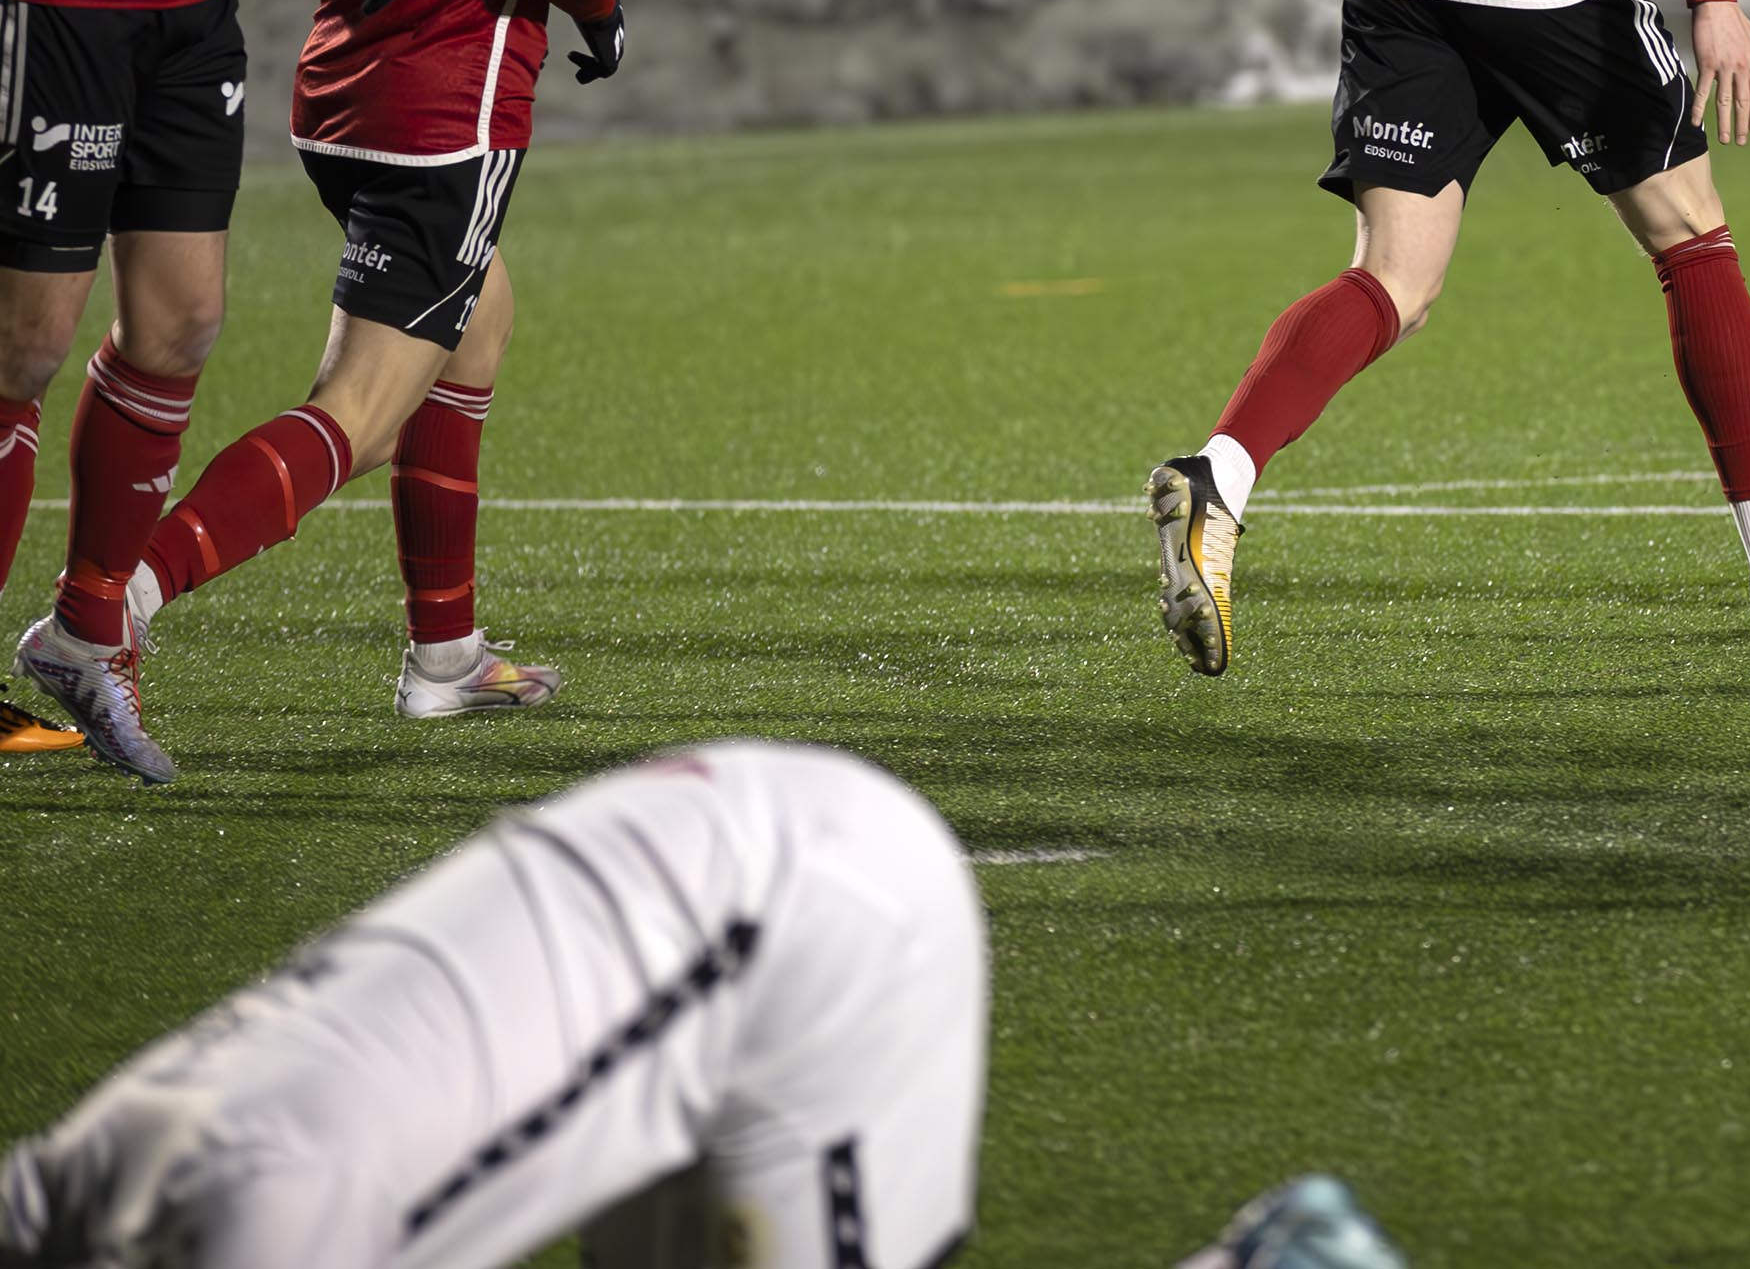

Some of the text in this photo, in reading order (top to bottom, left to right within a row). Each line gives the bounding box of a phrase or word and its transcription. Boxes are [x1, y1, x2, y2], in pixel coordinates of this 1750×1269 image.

[73, 123, 124, 142] INTER
[70, 140, 121, 159] SPORT
[17, 176, 58, 221] 14
[342, 241, 393, 273] ontér.
